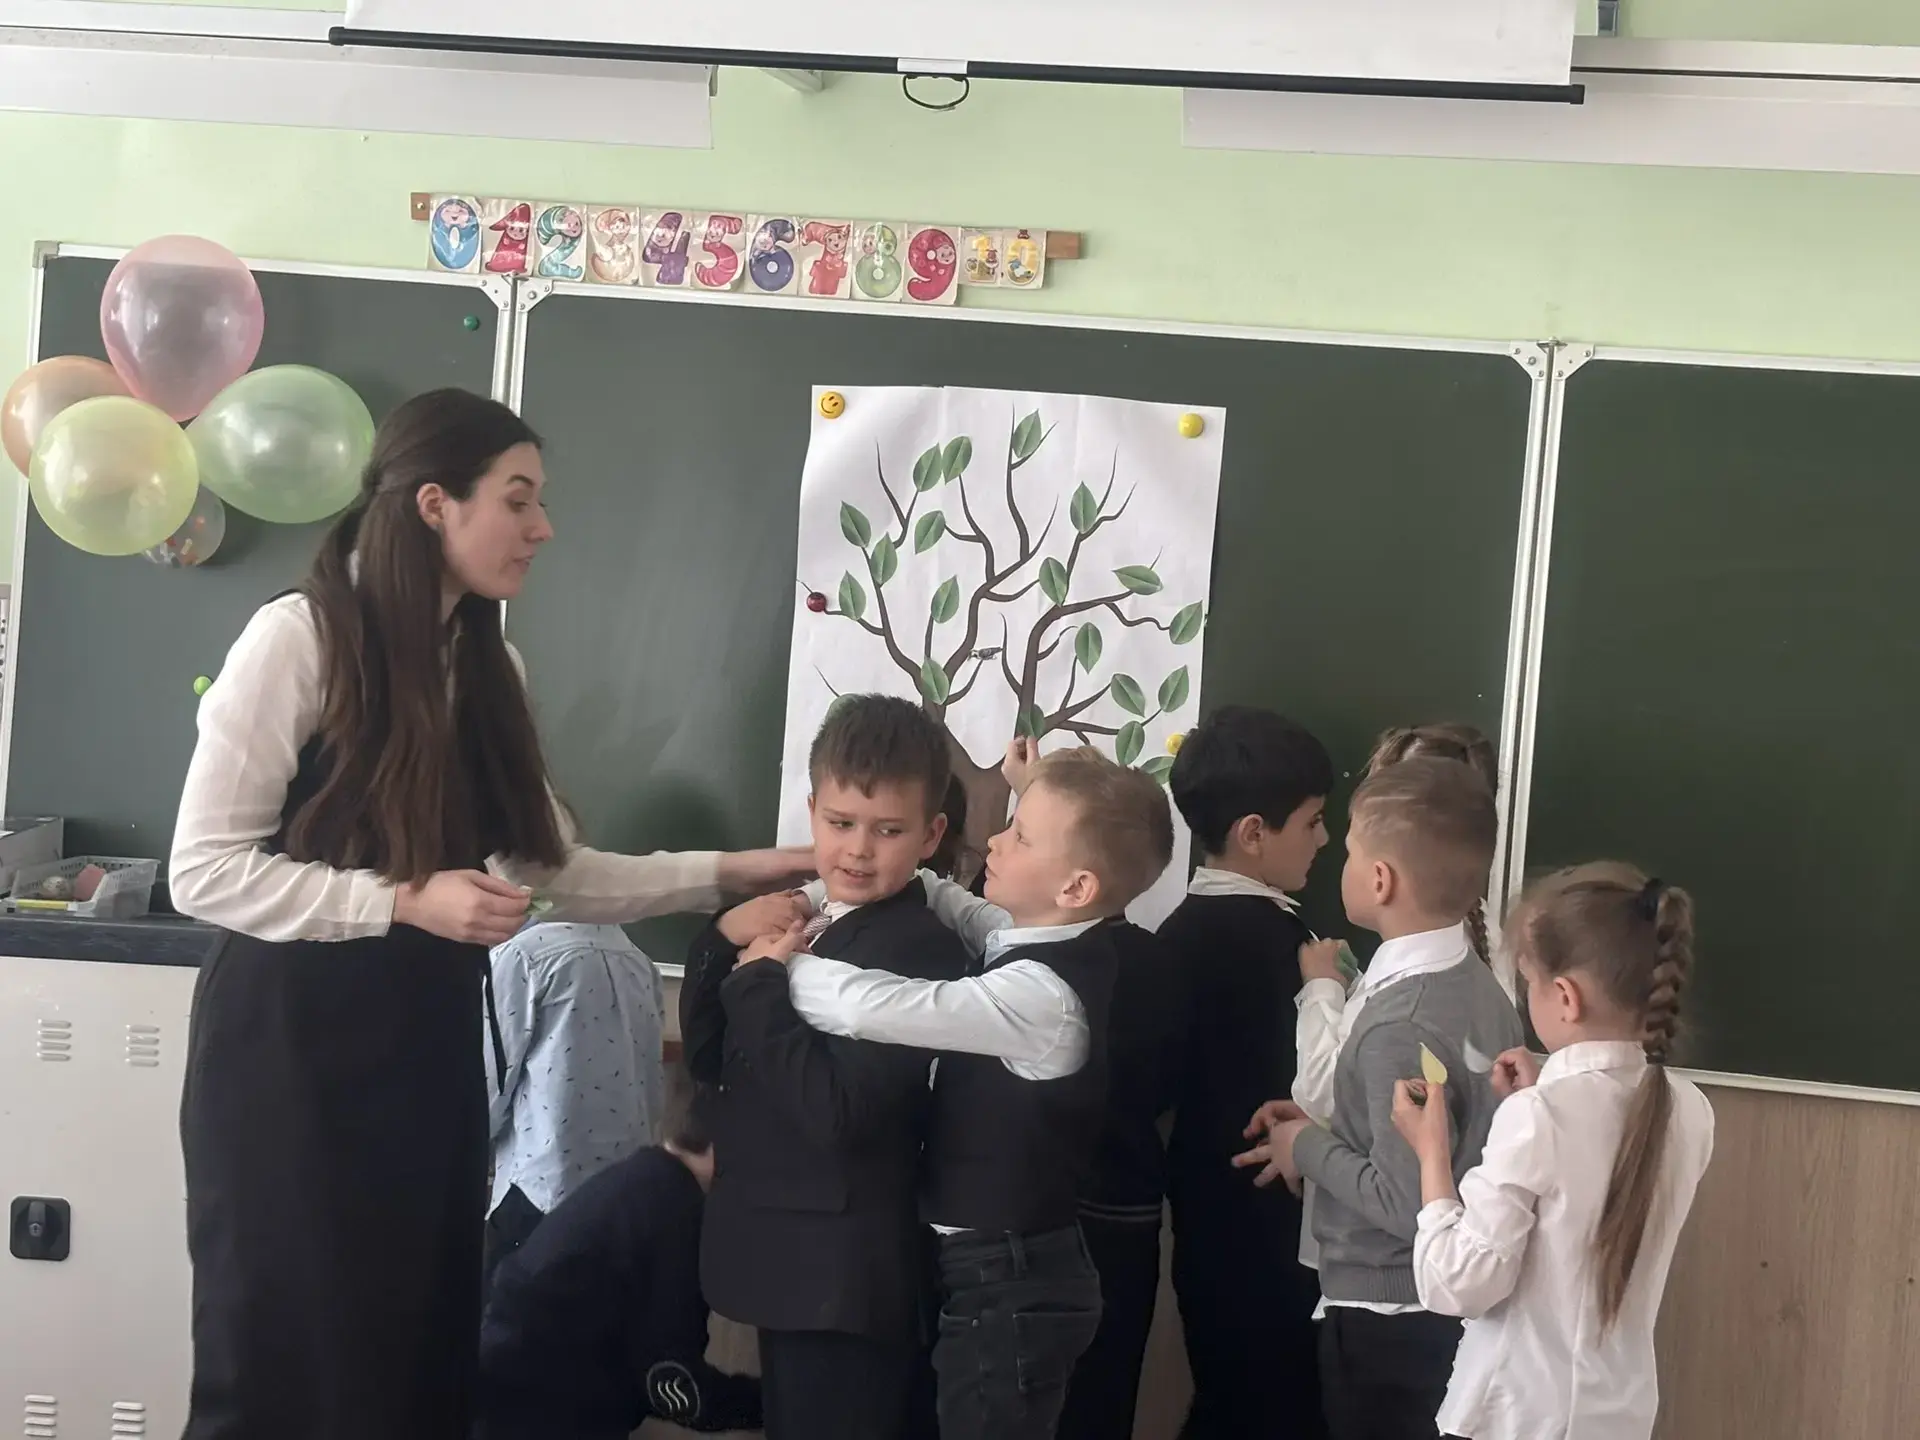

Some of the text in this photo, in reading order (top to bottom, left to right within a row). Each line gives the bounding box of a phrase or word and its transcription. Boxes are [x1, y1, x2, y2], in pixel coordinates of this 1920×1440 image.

[430, 199, 480, 270] 0
[484, 203, 531, 273] 1
[536, 205, 584, 281] 2
[590, 208, 635, 282] 3
[642, 212, 690, 286] 4
[694, 214, 743, 288] 5
[749, 218, 796, 292] 6
[802, 221, 851, 295] 7
[855, 224, 902, 298] 8
[907, 228, 957, 301] 9
